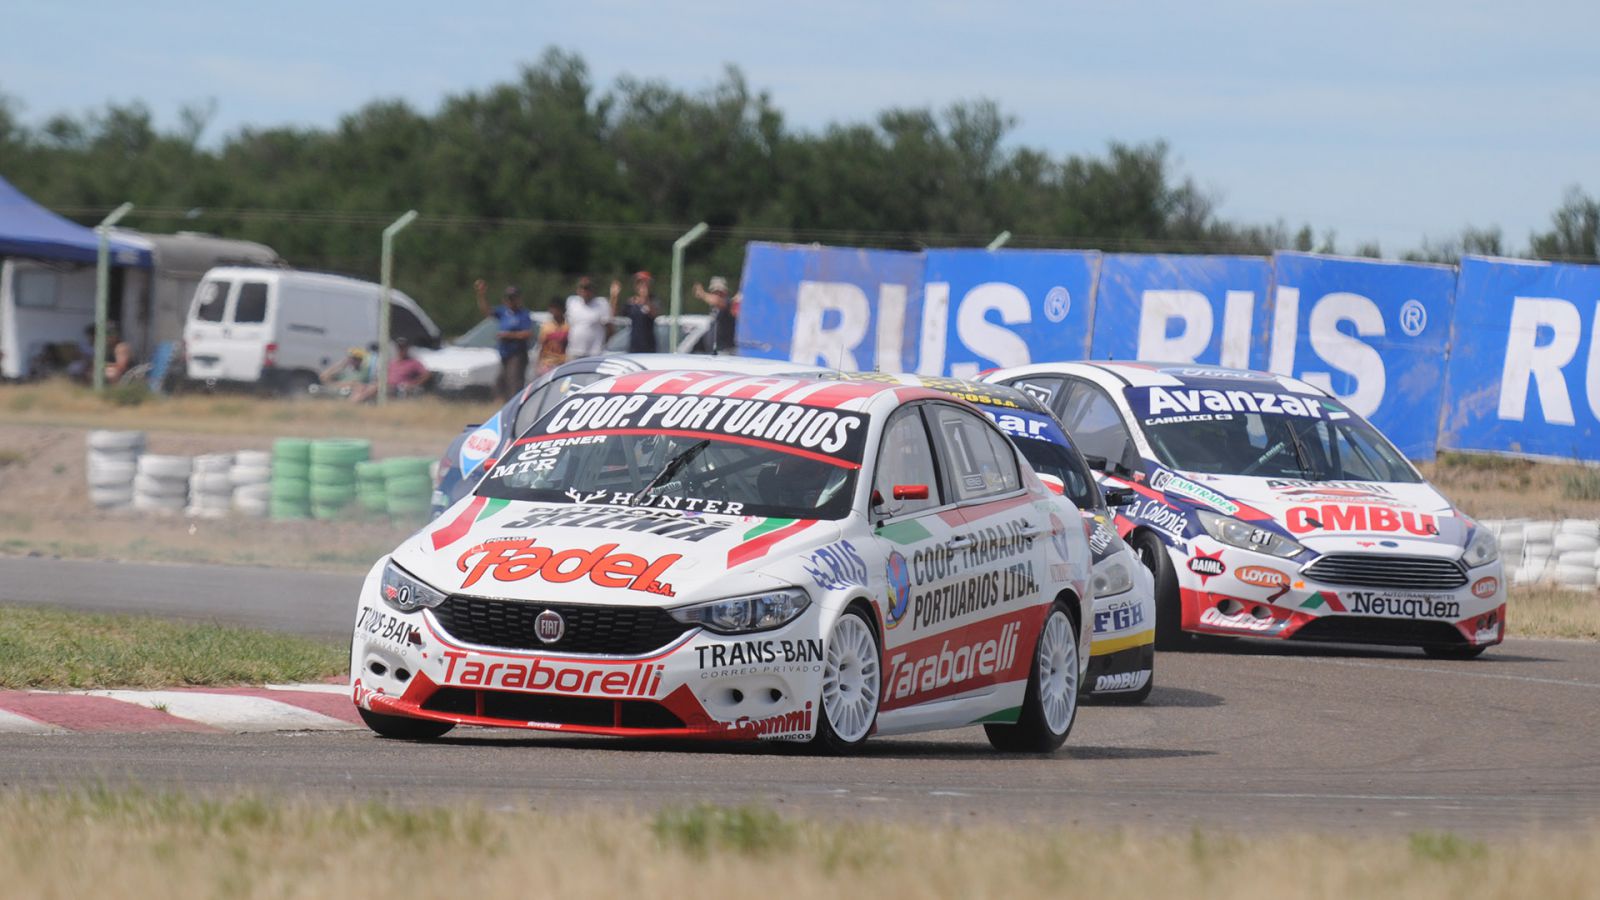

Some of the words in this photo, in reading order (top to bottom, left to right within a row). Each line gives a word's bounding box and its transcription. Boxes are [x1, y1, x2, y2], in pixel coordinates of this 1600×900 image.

[790, 282, 1032, 377] RUS
[1137, 286, 1386, 419] RUS
[1498, 296, 1600, 426] R
[1149, 386, 1322, 418] Avanzar
[546, 395, 648, 433] COOP.
[641, 396, 861, 453] PORTUARIOS
[1145, 414, 1213, 426] CARDUCCI
[1215, 413, 1233, 421] C3
[517, 446, 561, 461] C3
[524, 435, 608, 452] WERNER
[490, 458, 557, 479] MTR
[610, 492, 744, 515] HUNTER
[1140, 499, 1188, 535] Colonia
[501, 511, 728, 542] SELENIA
[1286, 505, 1436, 537] OMBU
[1251, 528, 1273, 546] 31
[456, 538, 683, 592] Fadel
[812, 540, 868, 588] RUS
[648, 580, 677, 598] S.A.
[913, 570, 999, 631] PORTUARIOS
[1003, 560, 1040, 602] LTDA.
[541, 619, 559, 635] FIAT
[1093, 603, 1144, 632] FGH
[694, 638, 823, 669] TRANS-BAN
[884, 621, 1021, 702] Taraborelli
[443, 651, 665, 697] Taraborelli
[700, 667, 757, 680] CORREO
[763, 664, 821, 673] PRIVADO
[1094, 671, 1141, 691] OMBU
